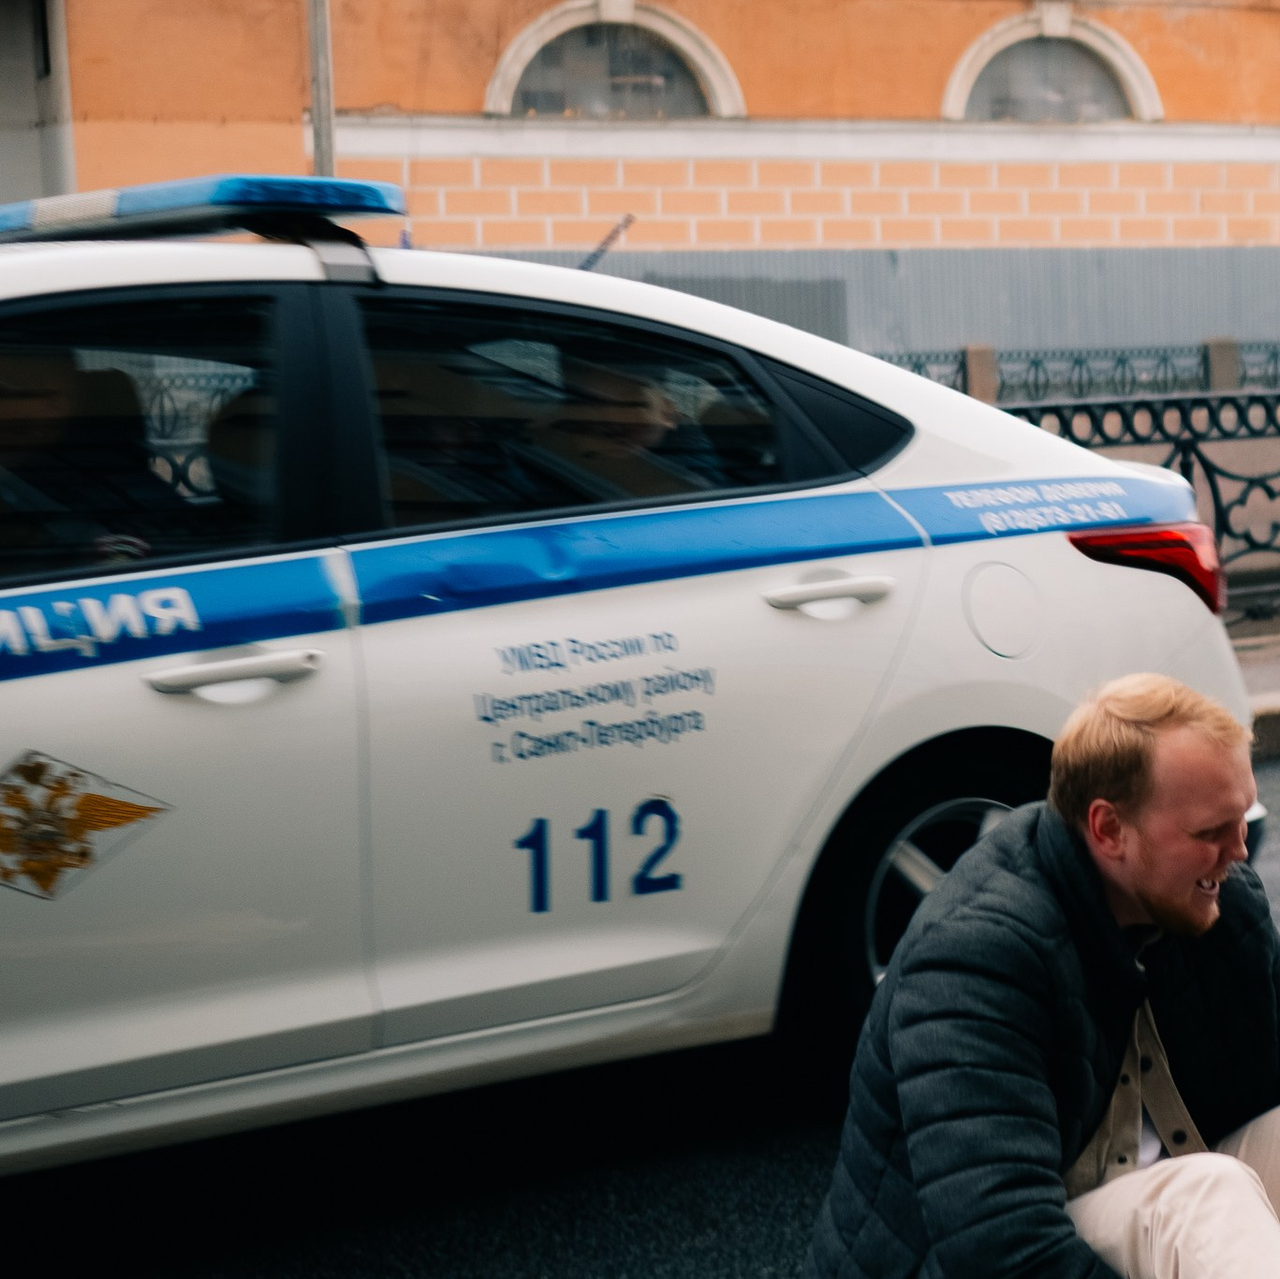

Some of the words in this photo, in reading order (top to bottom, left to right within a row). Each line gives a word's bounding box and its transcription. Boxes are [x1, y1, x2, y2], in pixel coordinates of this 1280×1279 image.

[495, 641, 567, 674] УМВД
[566, 638, 645, 664] России
[649, 632, 678, 652] по
[474, 680, 635, 724] Центральному
[642, 666, 715, 703] району
[514, 798, 682, 912] 112
